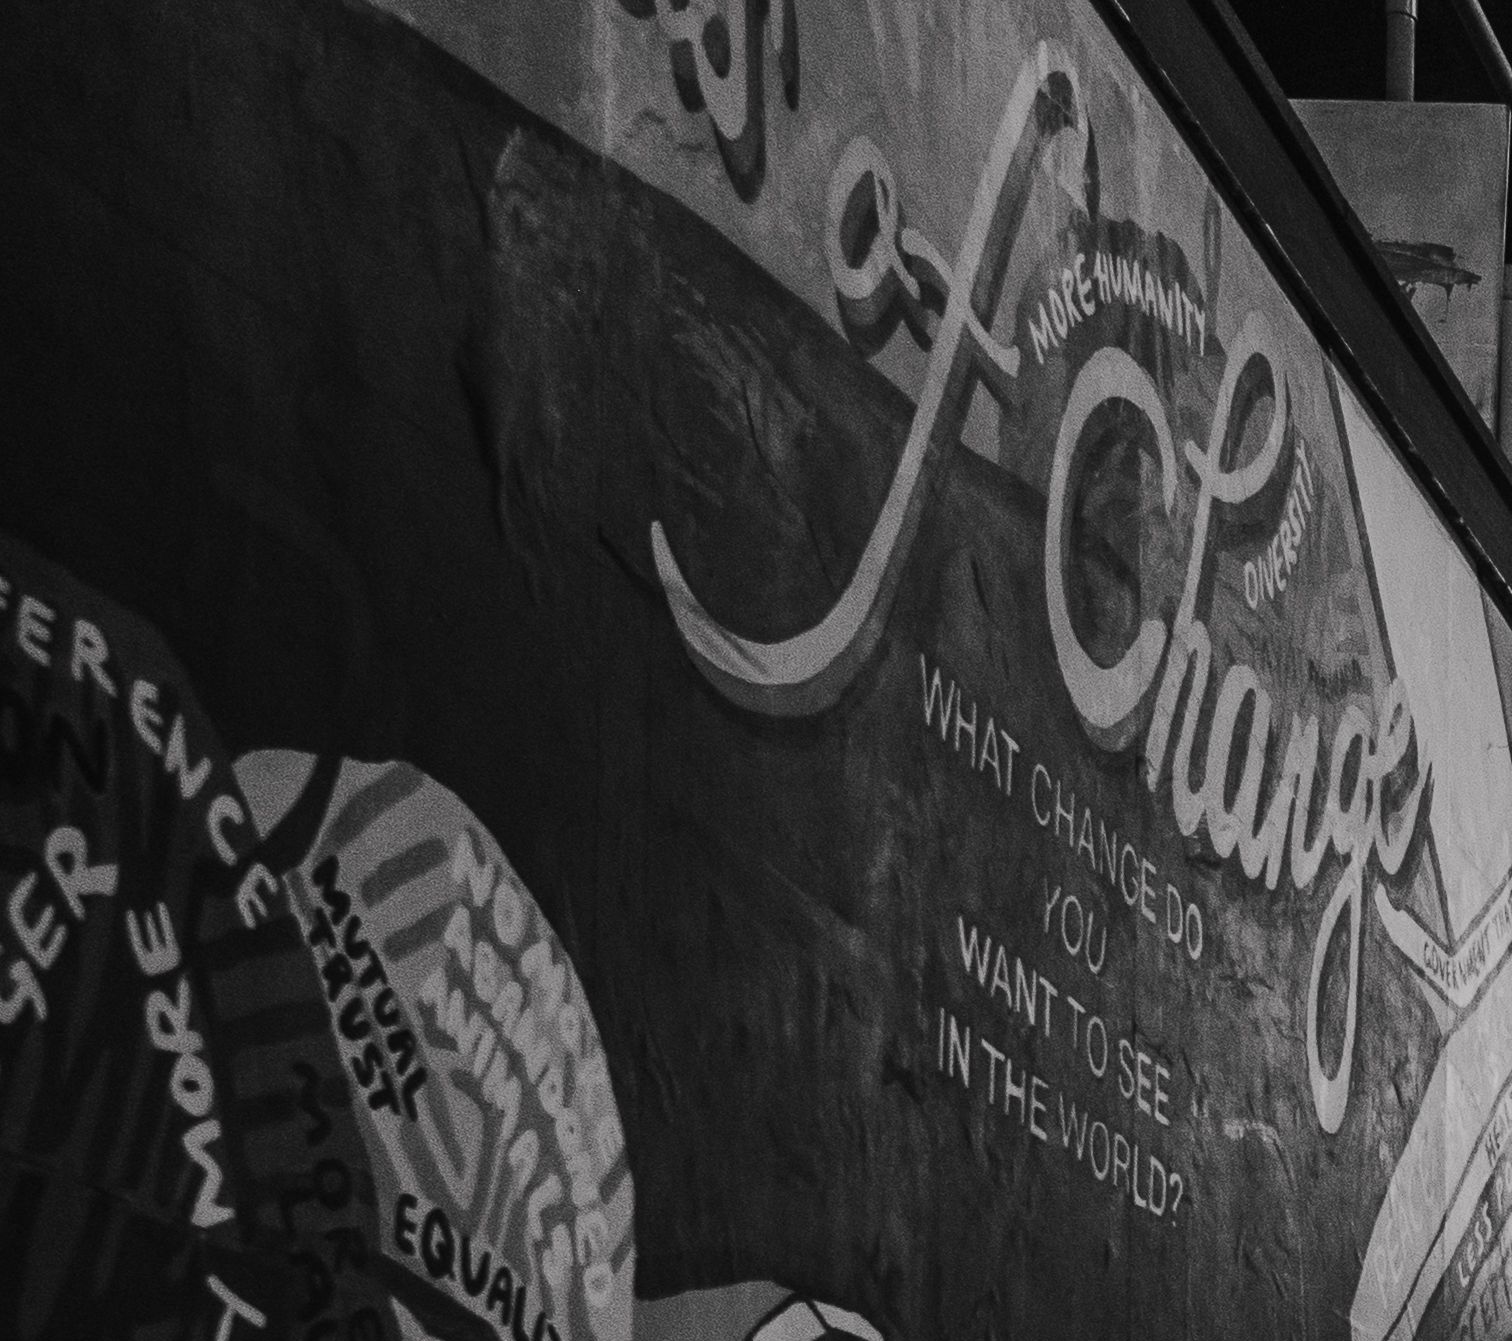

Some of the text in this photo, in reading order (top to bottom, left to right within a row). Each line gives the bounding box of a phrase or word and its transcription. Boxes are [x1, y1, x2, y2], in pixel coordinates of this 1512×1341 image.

[1028, 252, 1206, 364] MORE HUMANITY
[1243, 438, 1316, 609] DIVERSITY
[918, 653, 1204, 961] WHAT CHANGE DO
[1043, 310, 1438, 1136] Change
[313, 854, 427, 1122] MUTUAL
[453, 826, 528, 948] NO
[1041, 876, 1108, 975] YOU
[1422, 926, 1491, 990] GOVERNMENT
[124, 900, 236, 1228] MORE
[309, 906, 403, 1116] TRUST
[955, 913, 1172, 1127] WANT TO SEE
[937, 1005, 1186, 1228] IN THE WORLD?
[1456, 1201, 1494, 1288] LESS
